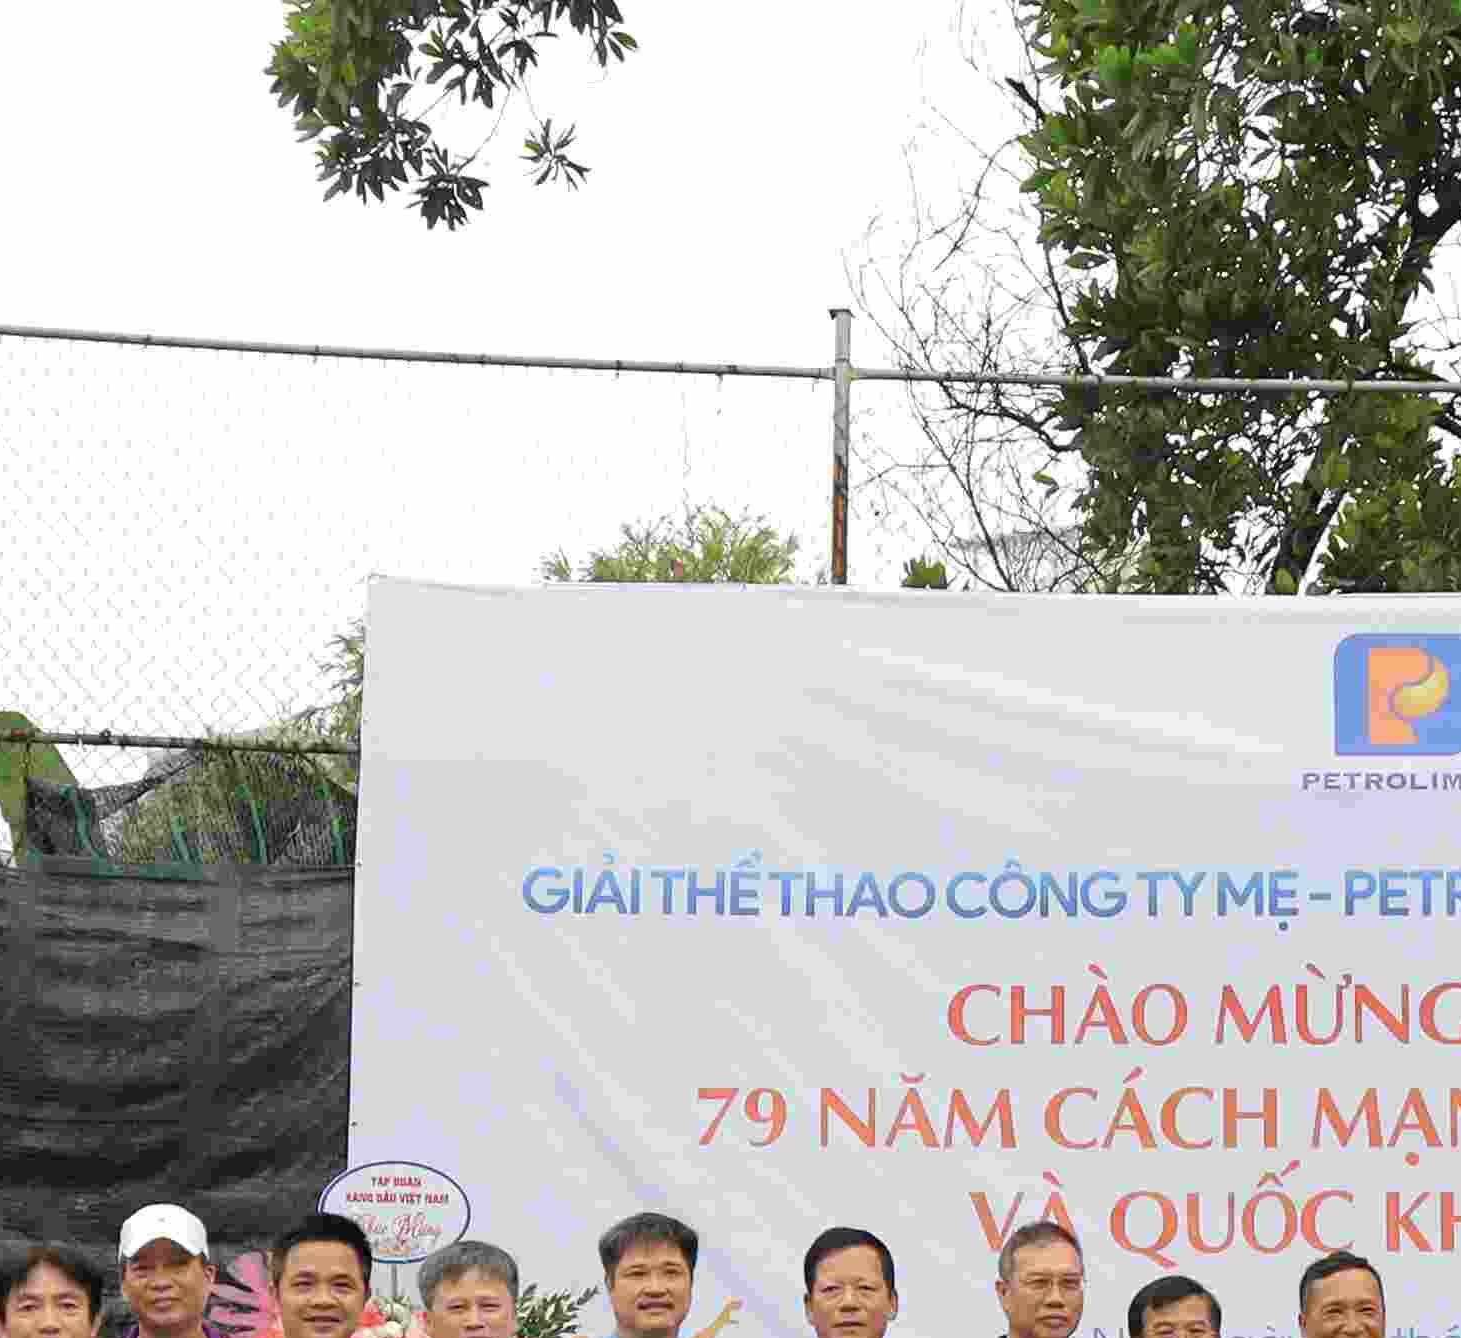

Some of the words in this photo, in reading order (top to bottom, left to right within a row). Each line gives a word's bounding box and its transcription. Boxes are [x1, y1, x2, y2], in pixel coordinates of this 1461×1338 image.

[522, 858, 641, 915] GIẢI
[650, 854, 760, 916] THỂ
[769, 871, 936, 919] THAO
[946, 858, 1128, 919] CÔNG
[1137, 871, 1207, 917] TY
[1217, 871, 1300, 932] MẸ
[946, 964, 1189, 1047] CHÀO
[697, 1087, 787, 1147] 79
[819, 1072, 1018, 1149] NĂM
[1043, 1066, 1281, 1149] CÁCH
[1109, 1160, 1357, 1268] QUỐC
